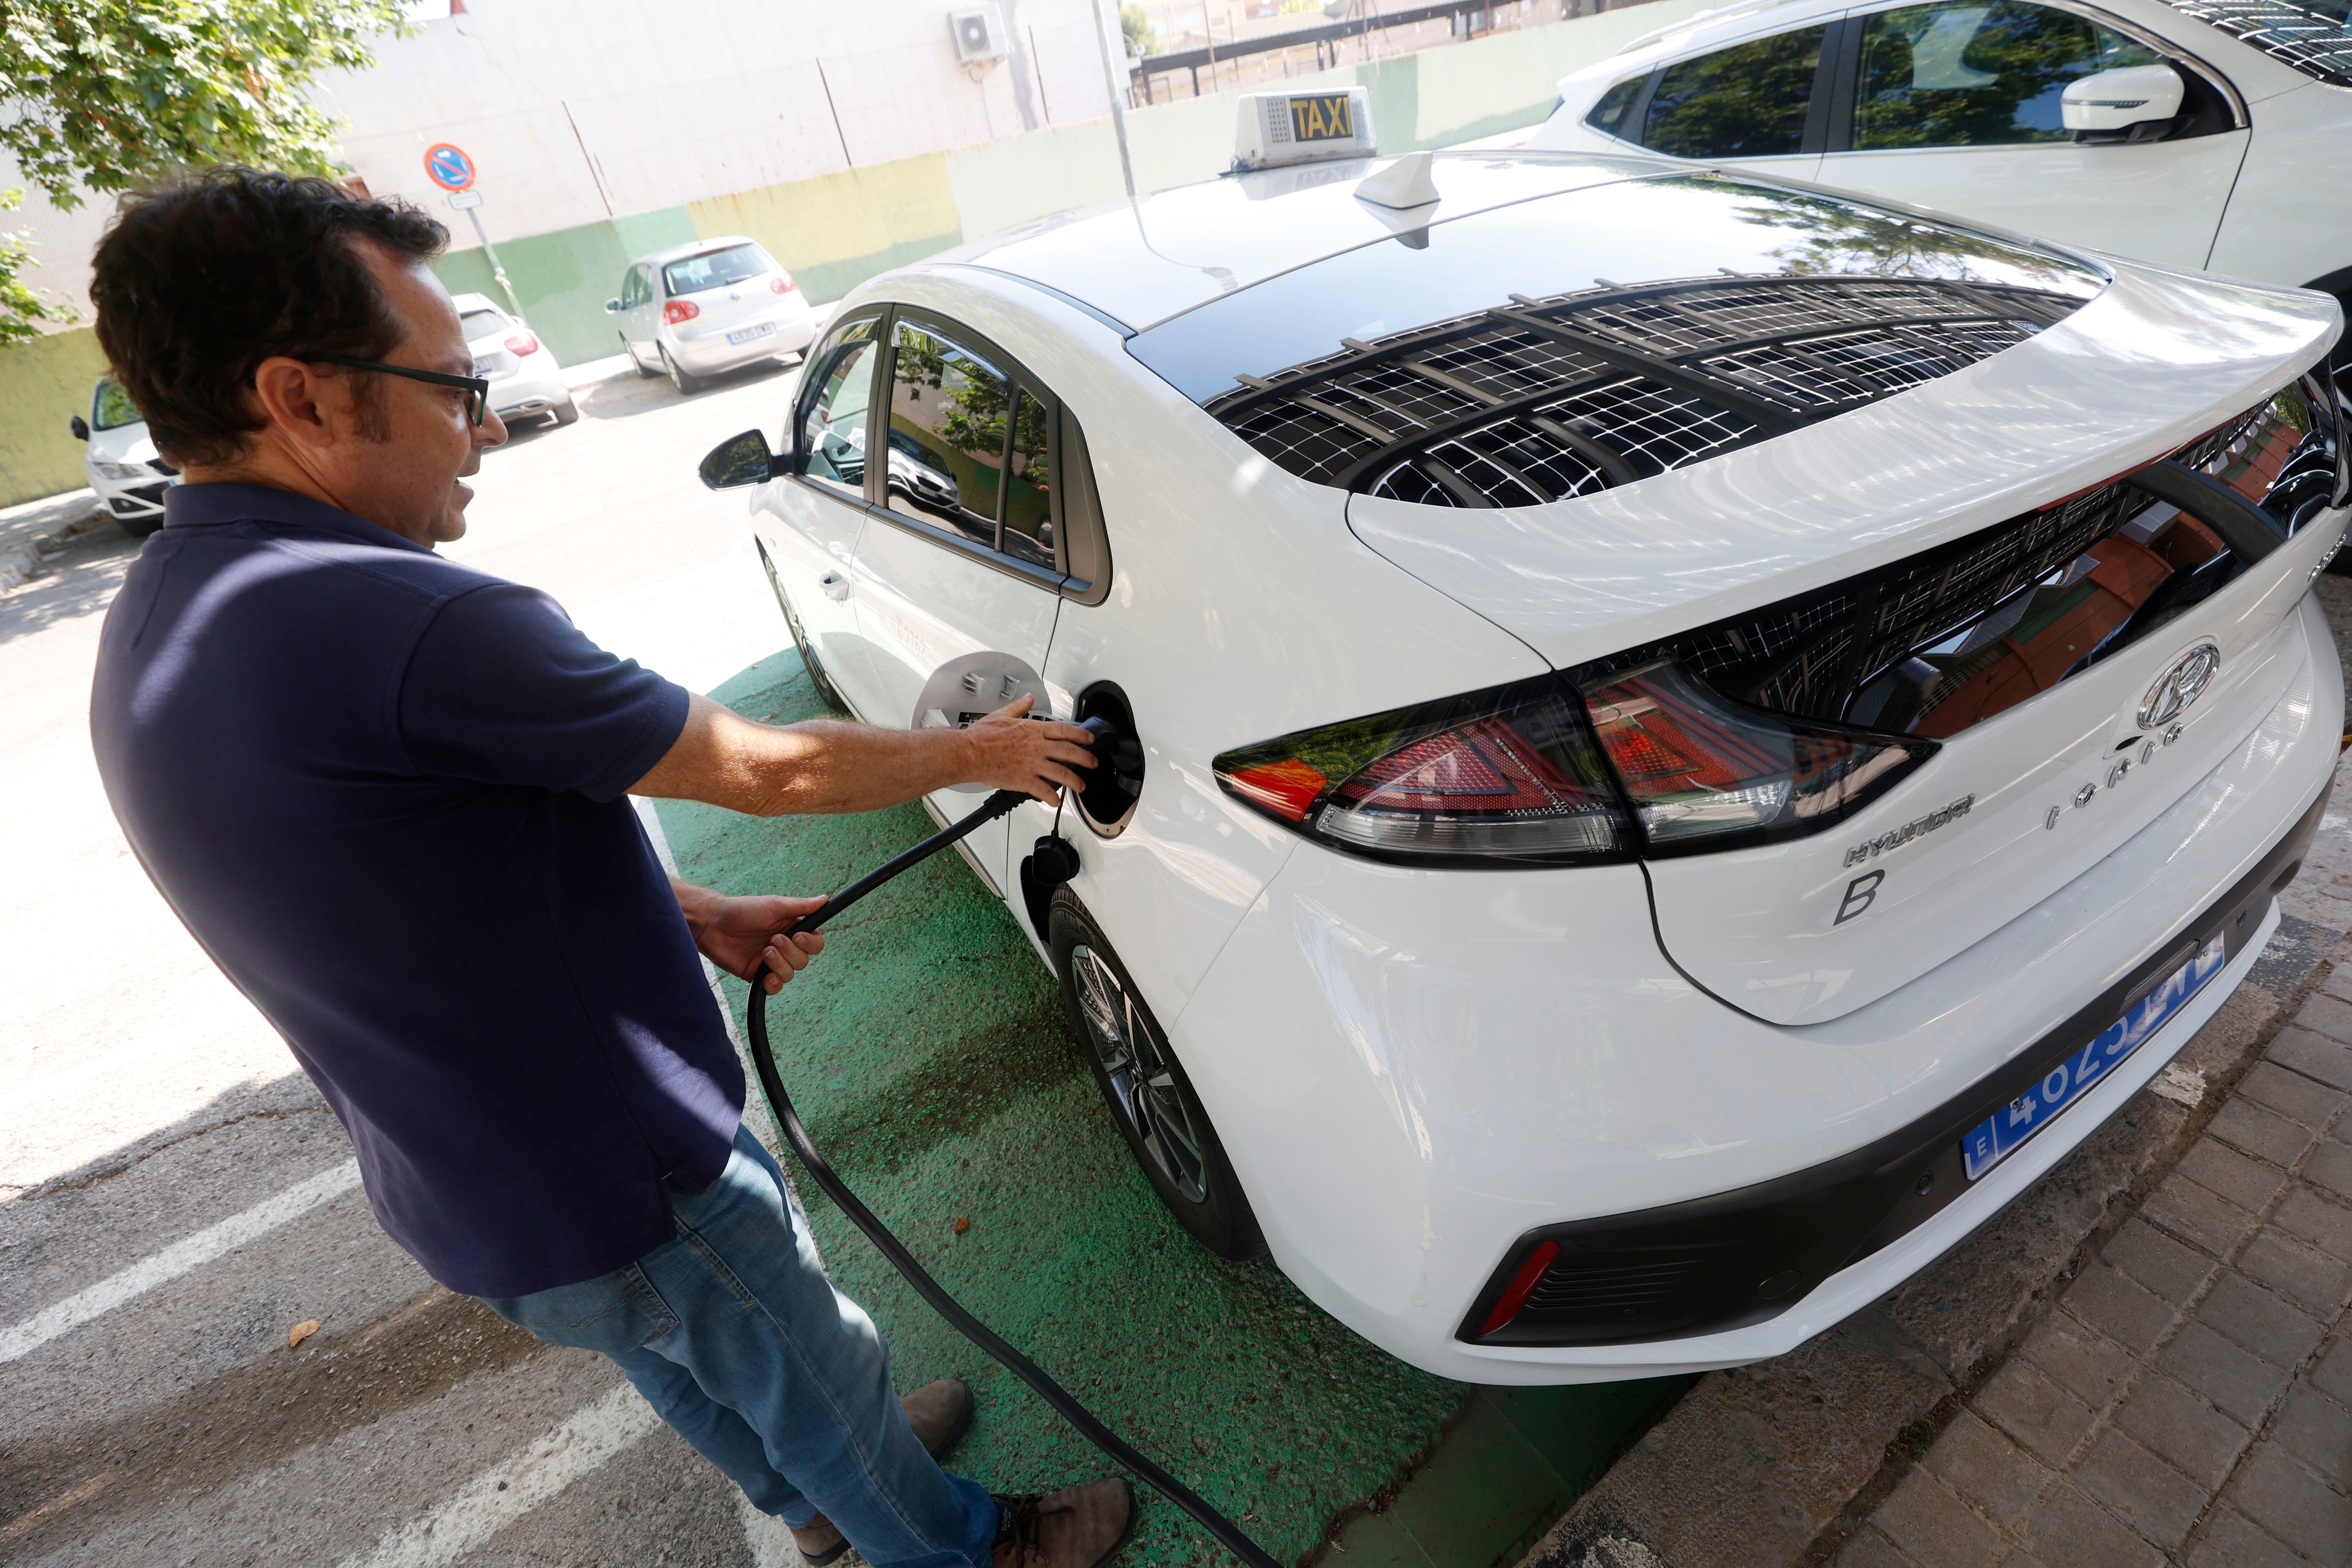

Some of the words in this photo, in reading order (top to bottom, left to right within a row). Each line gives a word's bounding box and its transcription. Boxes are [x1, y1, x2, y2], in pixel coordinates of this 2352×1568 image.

[1292, 97, 1353, 138] TAXI
[2046, 722, 2183, 830] IONIQ
[1844, 793, 1975, 868] HYUNDAI
[1833, 869, 1885, 926] B
[796, 1136, 805, 1149] CZPN
[1977, 1136, 1987, 1157] E
